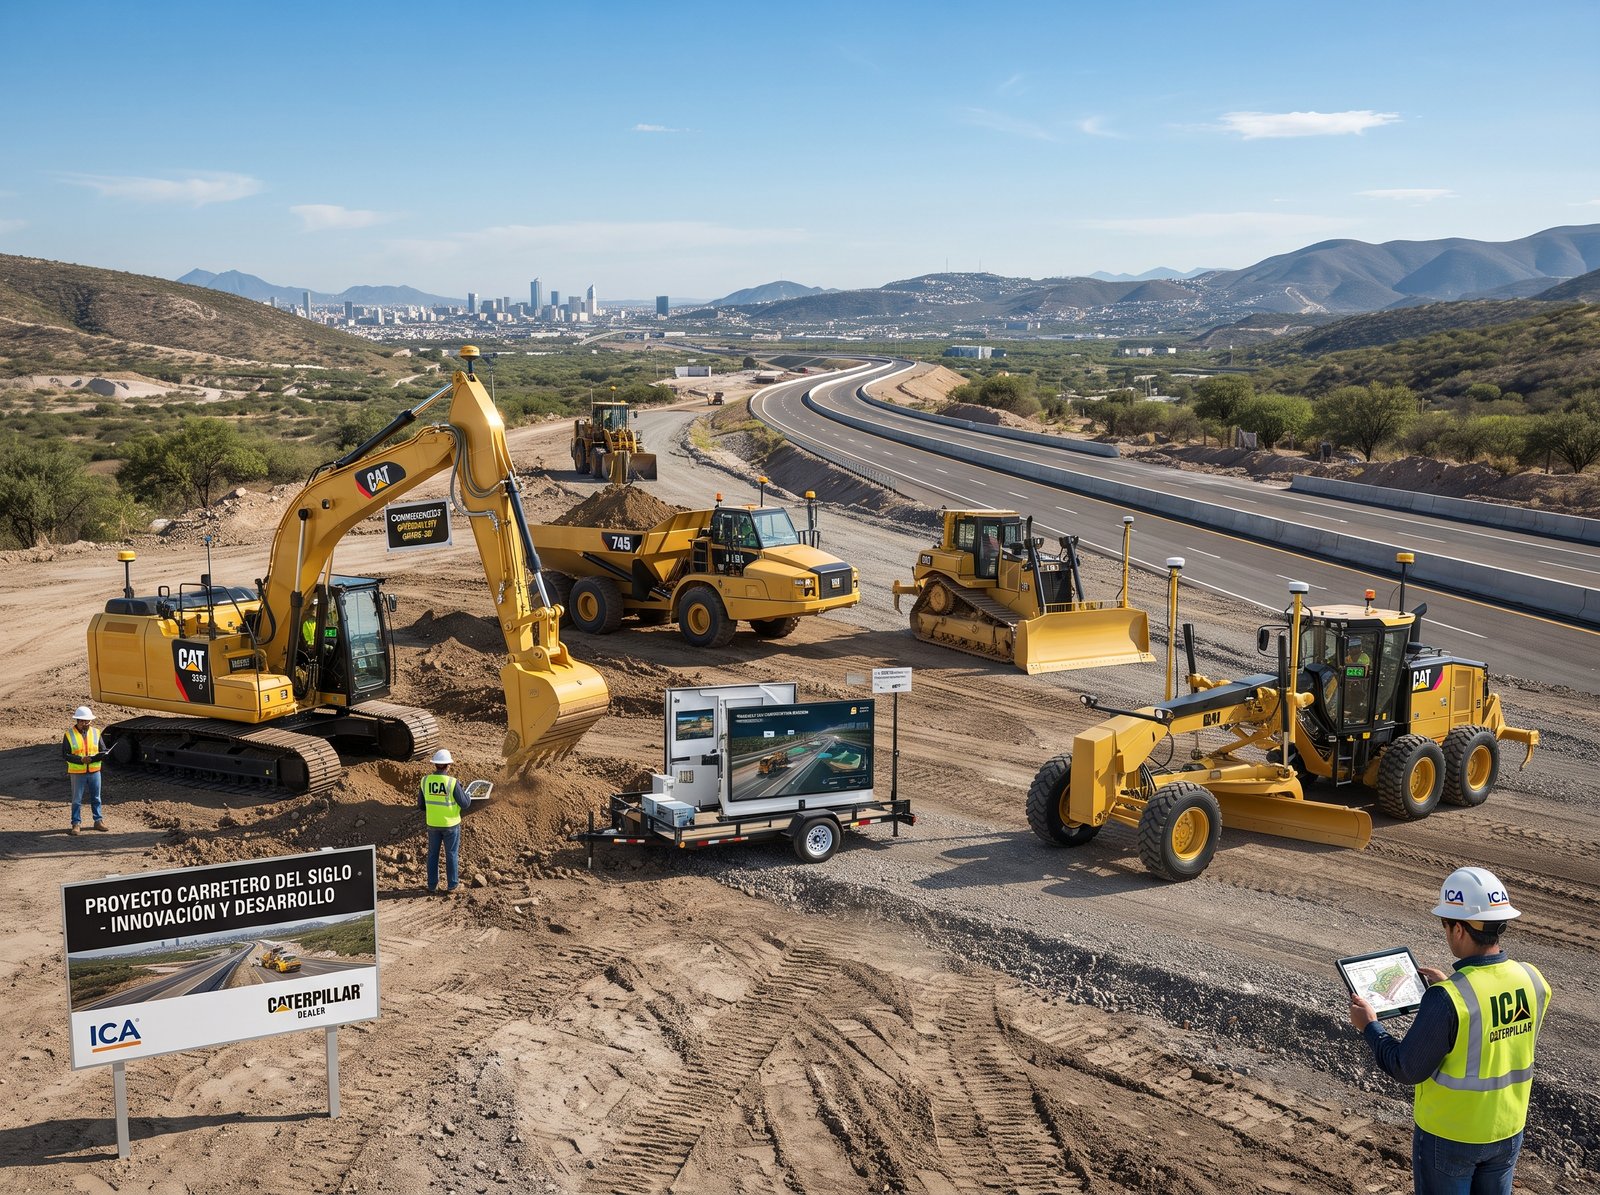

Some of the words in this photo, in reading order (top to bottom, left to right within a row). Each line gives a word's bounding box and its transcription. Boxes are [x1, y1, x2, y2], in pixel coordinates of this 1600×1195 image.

[367, 465, 390, 492] CAT
[611, 536, 631, 550] 745
[178, 648, 205, 672] CAT
[1412, 669, 1431, 691] CAT
[428, 782, 447, 794] ICA
[85, 888, 172, 915] PROYECTO
[177, 874, 271, 903] CARRETERO
[275, 870, 304, 891] DEL
[308, 864, 352, 885] SIGLO
[1445, 889, 1464, 902] ICA
[1487, 891, 1508, 903] ICA
[111, 901, 216, 933] INNOVACIÓN
[219, 900, 232, 916] Y
[235, 887, 335, 916] DESARROLLO
[267, 984, 361, 1014] CATERPILLAR
[1490, 988, 1531, 1027] ICA
[297, 1006, 326, 1019] DEALER
[90, 1019, 141, 1047] ICA
[1489, 1022, 1532, 1043] CATERPILLAR
